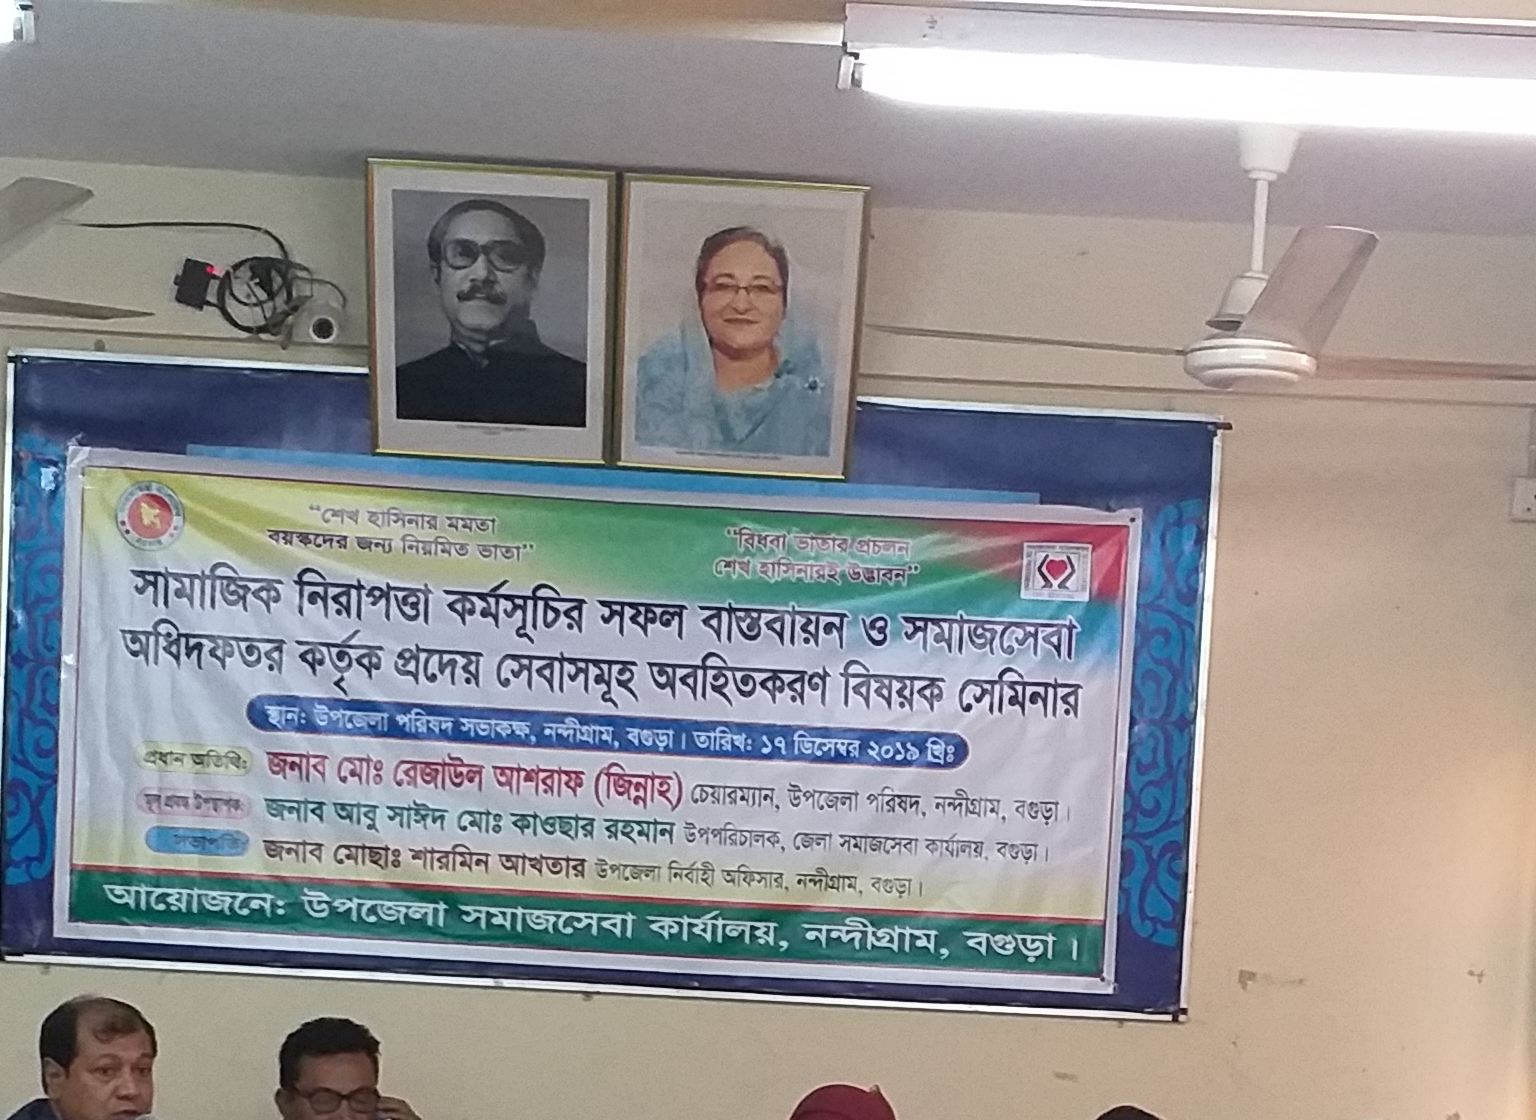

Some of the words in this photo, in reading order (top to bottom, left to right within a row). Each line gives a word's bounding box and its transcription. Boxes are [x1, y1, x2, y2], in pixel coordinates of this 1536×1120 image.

[267, 529, 347, 550] বয়স্কদের
[355, 536, 393, 554] জন্য
[401, 534, 469, 557] নিয়মিত
[367, 507, 438, 531] হাসিনার
[446, 516, 496, 535] মমতা
[794, 535, 848, 555] ভাতার
[855, 539, 910, 558] প্রচলন
[713, 558, 750, 577] শেখ
[758, 559, 839, 583] হাসিনারই
[130, 564, 284, 613] সামাজিক
[293, 567, 432, 625] নিরাপত্তা
[443, 580, 587, 644] কর্মসূচির
[599, 599, 688, 640] সফল
[700, 603, 849, 650] বাস্তবায়ন
[861, 615, 888, 646] ও
[903, 612, 1079, 661] সমাজসেবা
[120, 620, 287, 672] অধিদফতর
[296, 629, 384, 695] কর্তৃক
[394, 646, 484, 688] প্রদেয়
[496, 650, 638, 709] সেবাসমূহ
[647, 652, 830, 706] অবহিতকরণ
[841, 660, 946, 711] বিষয়ক
[958, 668, 1084, 719] সেমিনার
[313, 703, 389, 732] উপজেলা
[396, 709, 454, 736] পরিষদ
[761, 735, 786, 755] ১৭
[793, 730, 861, 758] ডিসেম্বর
[867, 741, 920, 762] ২০১৯
[266, 750, 330, 784] জনাব
[337, 752, 383, 787] মোঃ
[393, 754, 485, 793] রেজাউল
[492, 762, 585, 799] আশরাফ
[788, 783, 859, 813] উপজেলা
[264, 797, 326, 825] জনাব
[333, 800, 379, 831] আবু
[386, 800, 447, 832] সাঈদ
[457, 807, 503, 835] মোঃ
[511, 811, 595, 841] কাওছার
[603, 816, 676, 845] রহমান
[792, 830, 832, 854] জেলা
[838, 833, 918, 857] সমাজসেবা
[263, 838, 324, 864] জনাব
[410, 842, 489, 874] শারমিন
[498, 850, 586, 882] আখতার
[595, 858, 662, 886] উপজেলা
[667, 861, 714, 889] নির্বাহী
[301, 886, 449, 930] উপজেলা
[459, 902, 635, 940] সমাজসেবা
